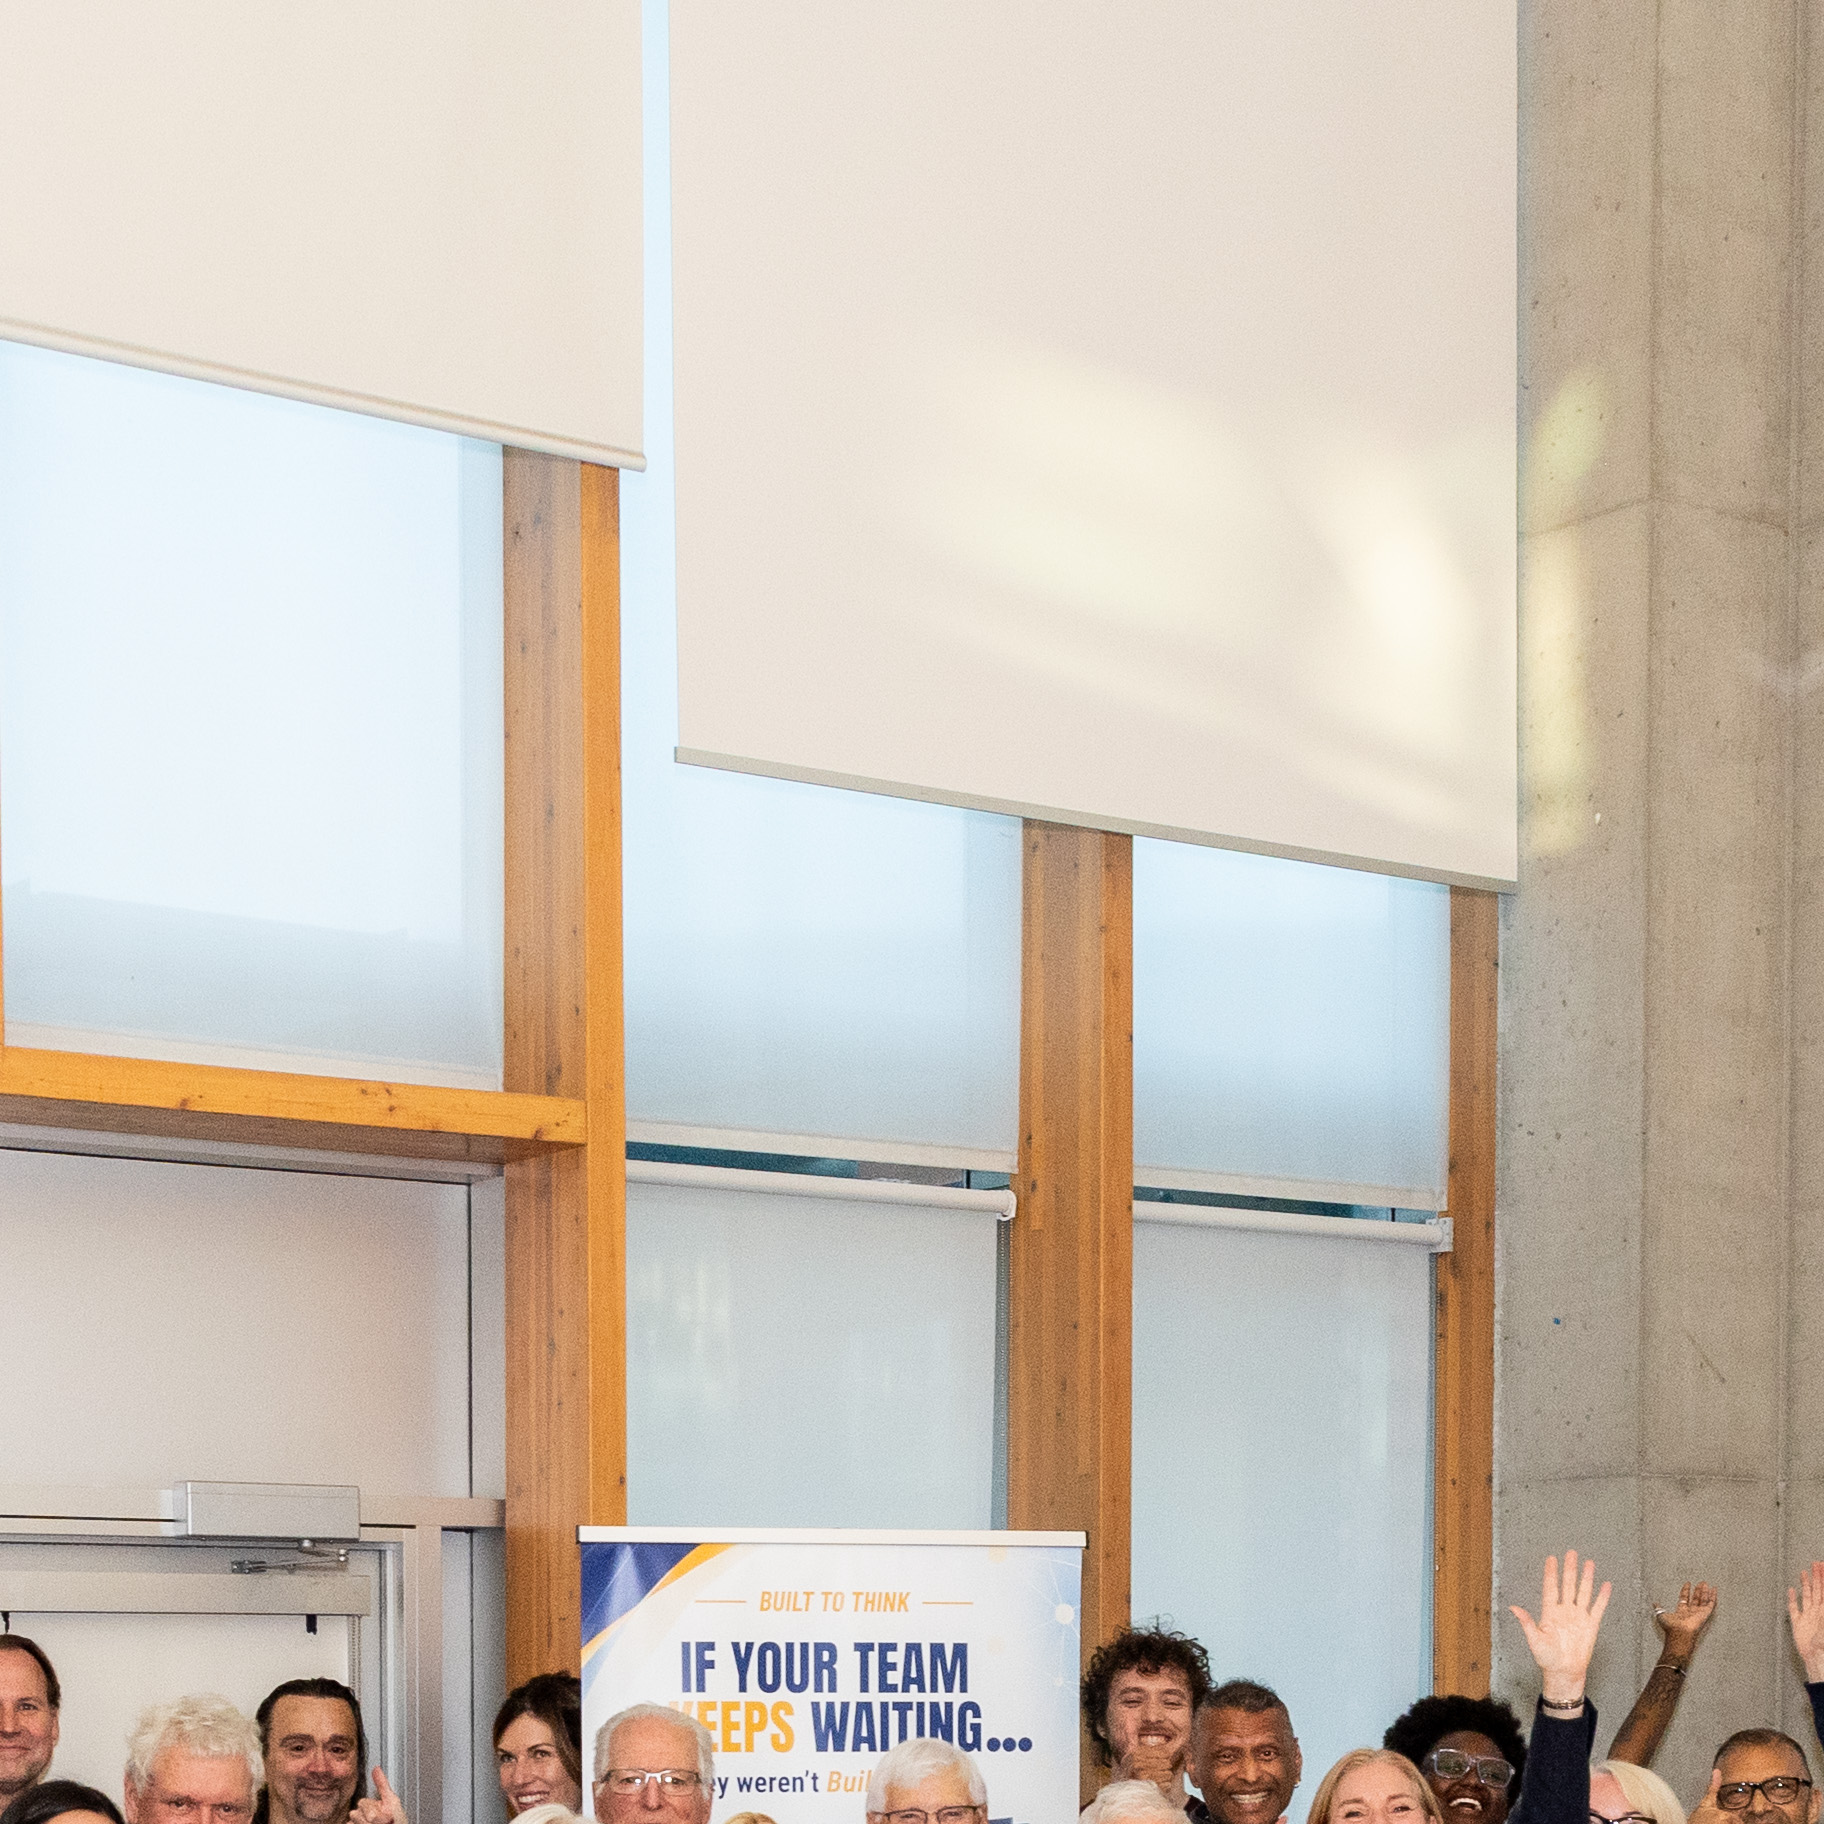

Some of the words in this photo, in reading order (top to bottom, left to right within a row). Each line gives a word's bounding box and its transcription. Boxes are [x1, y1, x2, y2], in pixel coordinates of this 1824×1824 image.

[759, 1591, 812, 1612] BUILT
[821, 1591, 844, 1612] TO
[853, 1592, 910, 1613] THINK
[681, 1641, 715, 1693] IF
[731, 1641, 837, 1693] YOUR
[854, 1642, 968, 1694] TEAM
[737, 1770, 819, 1793] weren't
